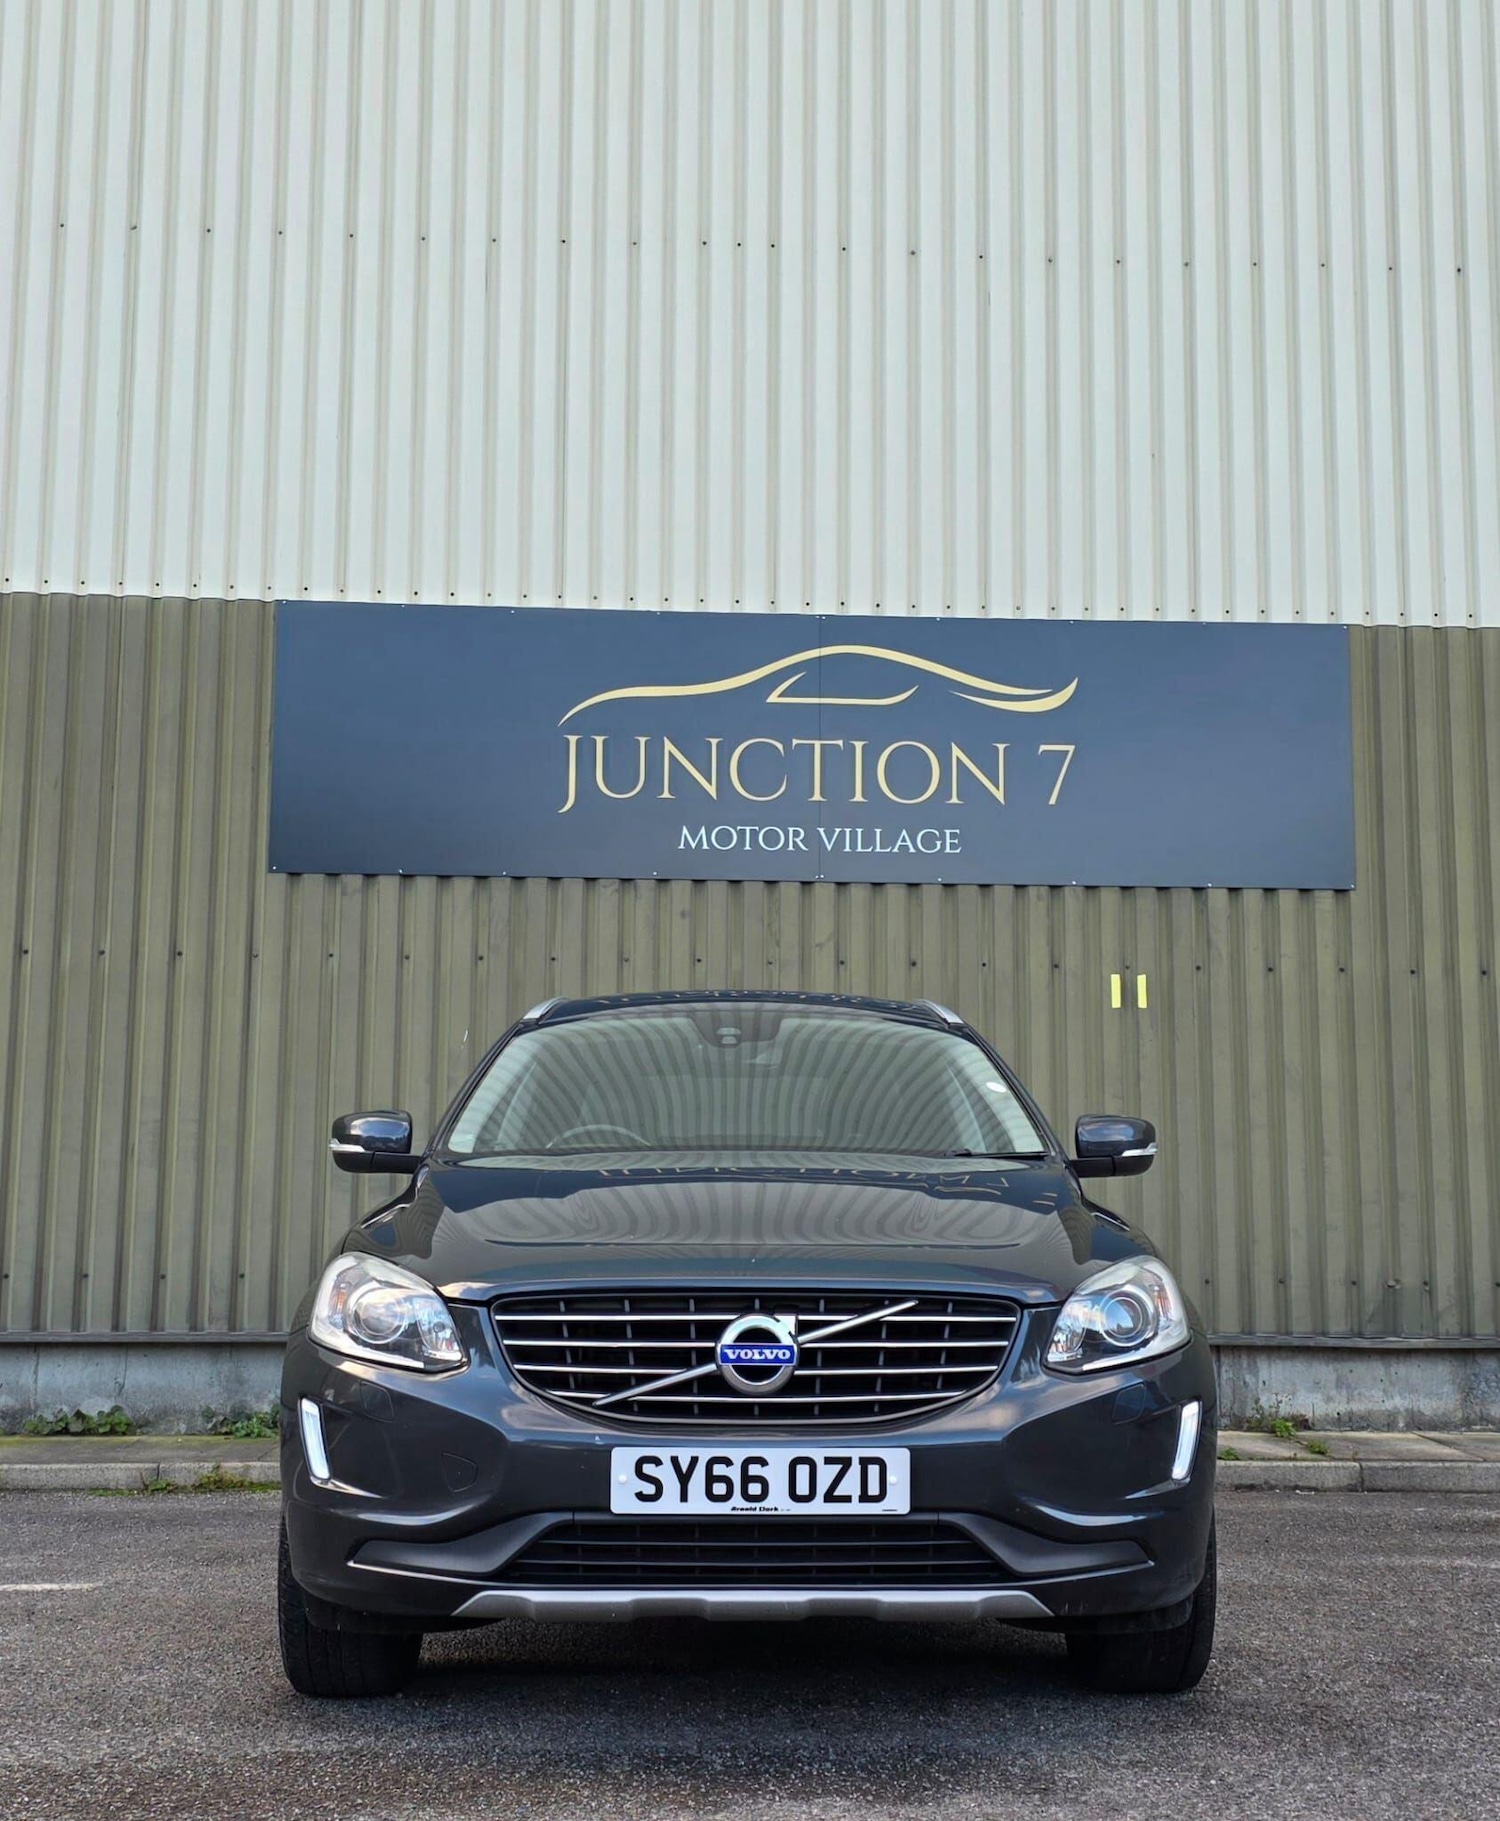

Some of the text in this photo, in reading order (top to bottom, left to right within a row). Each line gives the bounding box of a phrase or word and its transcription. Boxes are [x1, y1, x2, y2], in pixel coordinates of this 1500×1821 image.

[557, 734, 1077, 813] JUNCTION 7
[677, 825, 962, 854] MOTOR VILLAGE
[723, 1348, 791, 1360] VOLVO
[634, 1455, 888, 1504] SY66 OZD
